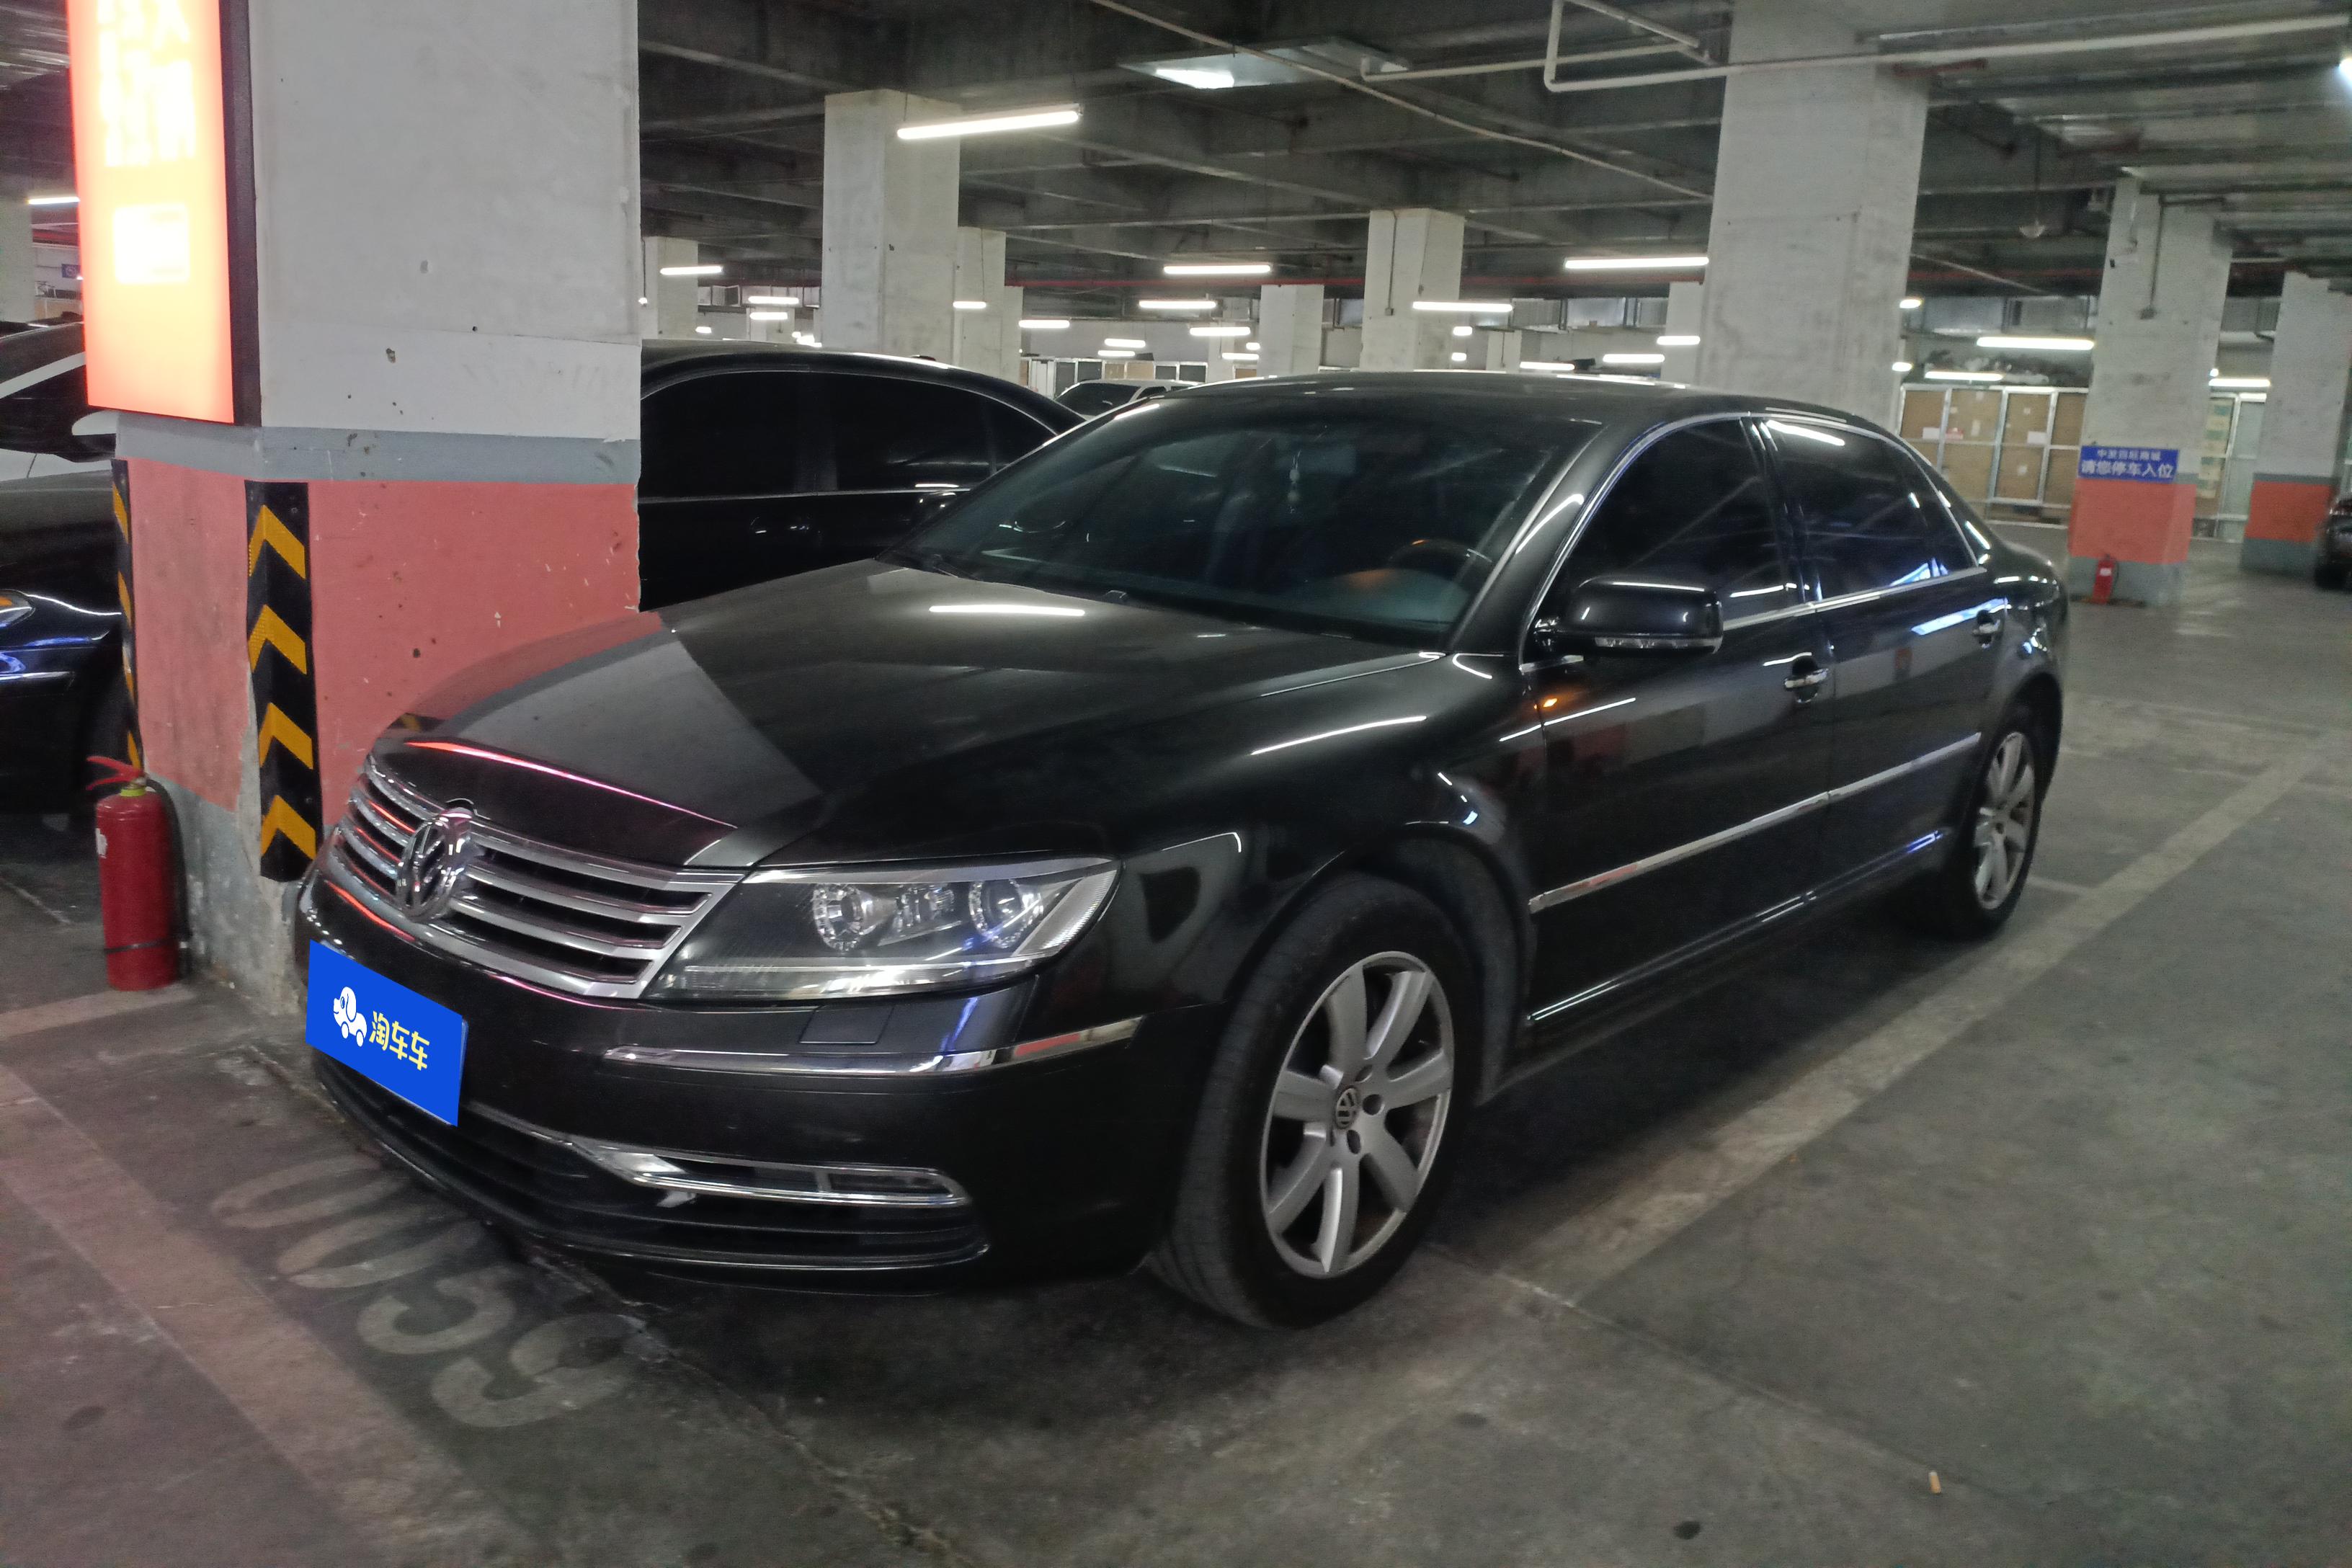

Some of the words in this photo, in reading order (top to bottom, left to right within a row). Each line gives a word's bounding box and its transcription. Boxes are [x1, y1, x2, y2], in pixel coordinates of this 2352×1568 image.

[2081, 459, 2174, 478] 请您停车入位
